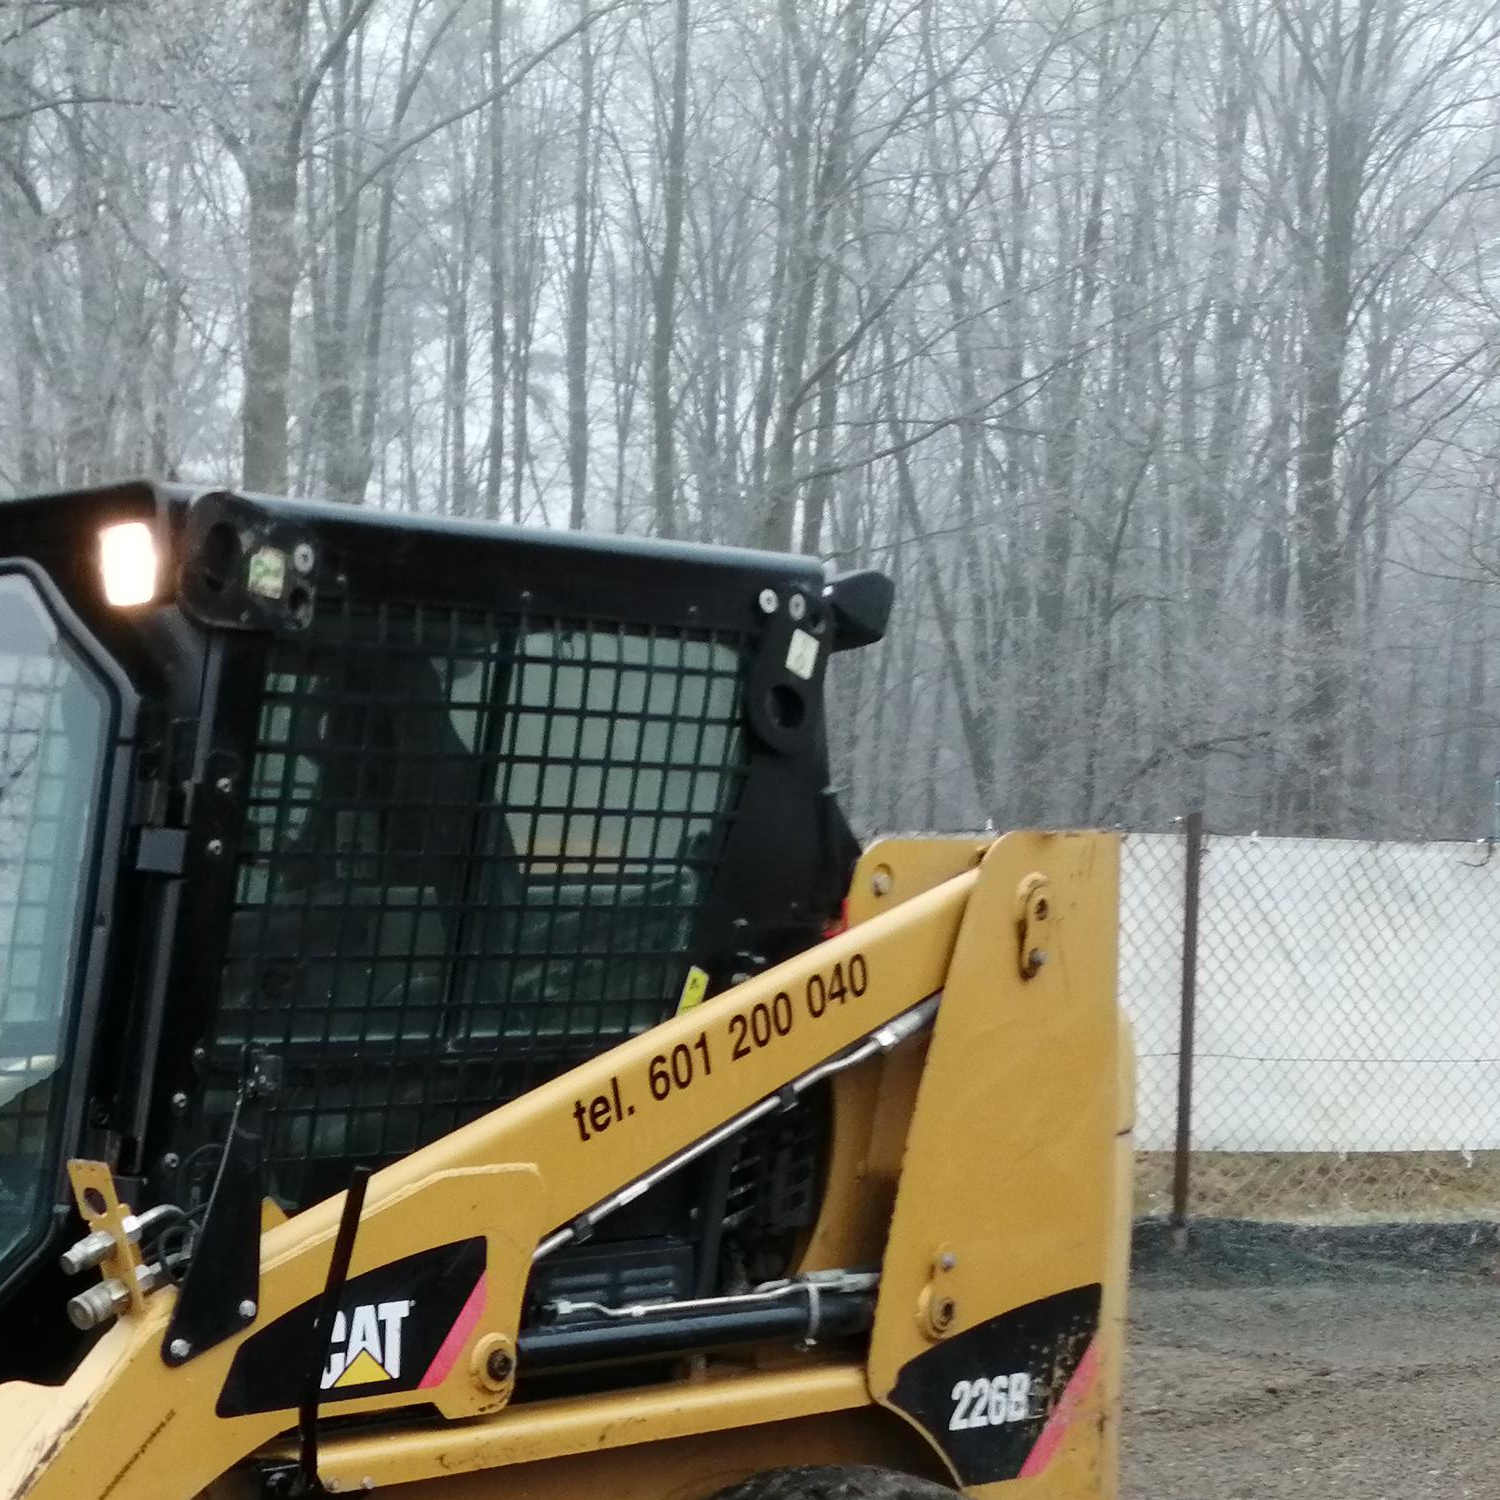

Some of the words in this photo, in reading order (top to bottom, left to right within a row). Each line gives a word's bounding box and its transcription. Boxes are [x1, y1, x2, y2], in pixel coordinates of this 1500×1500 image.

[572, 1077, 636, 1142] tel.
[648, 1032, 712, 1102] 601
[728, 993, 793, 1062] 200
[805, 953, 868, 1018] 040
[948, 1371, 1032, 1431] 226B
